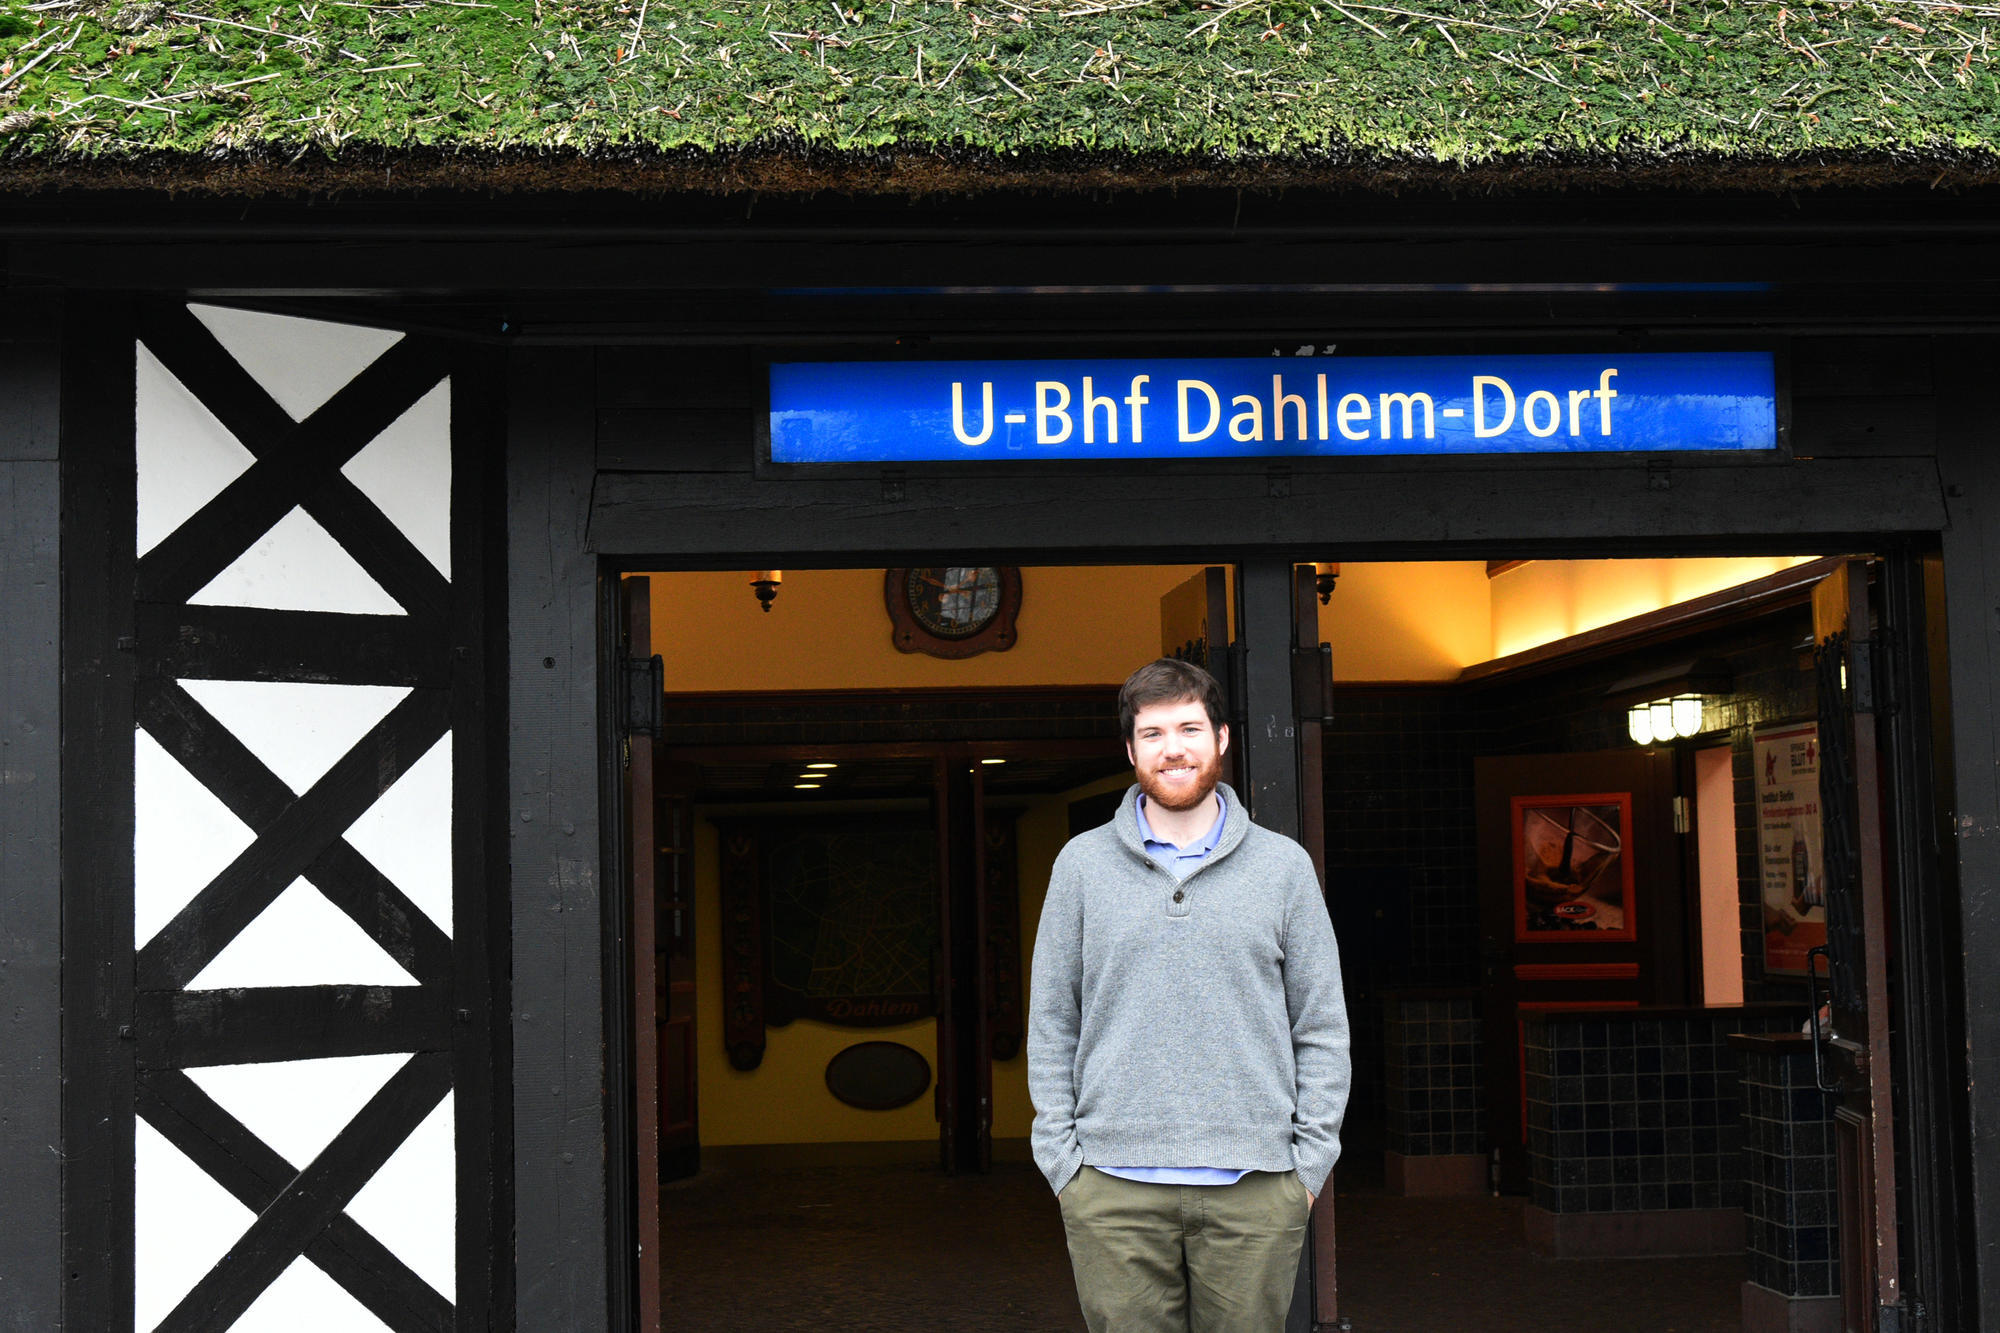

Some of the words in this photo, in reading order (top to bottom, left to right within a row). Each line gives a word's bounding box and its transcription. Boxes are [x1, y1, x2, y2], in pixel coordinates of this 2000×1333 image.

[951, 374, 1150, 446] U-Bhf
[1176, 368, 1618, 443] Dahlem-Dorf
[824, 999, 920, 1018] Dahlem
